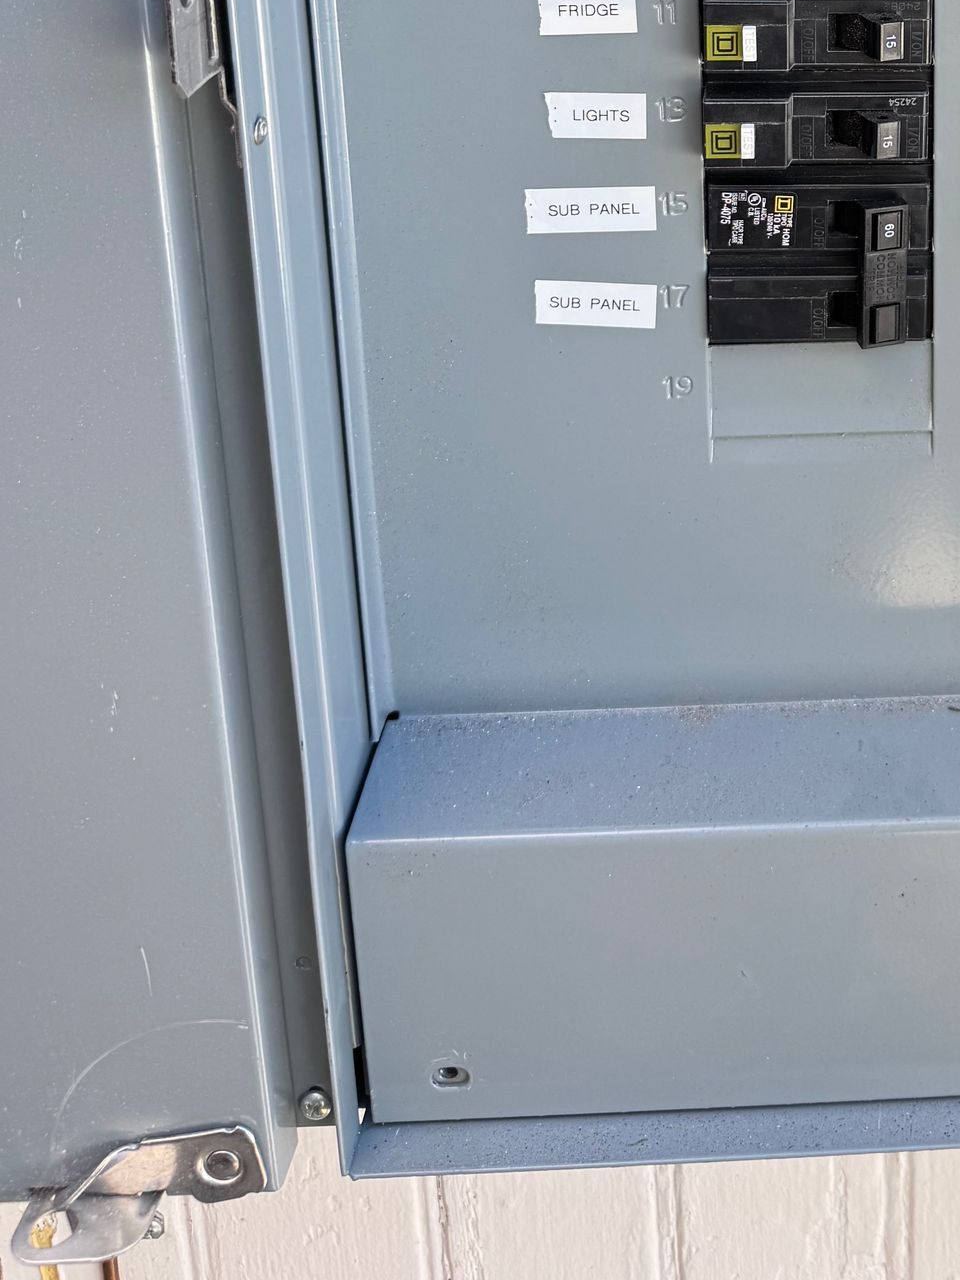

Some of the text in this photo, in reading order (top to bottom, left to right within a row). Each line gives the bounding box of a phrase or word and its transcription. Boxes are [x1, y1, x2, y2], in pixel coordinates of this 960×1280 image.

[558, 4, 619, 16] FRIDGE
[653, 0, 677, 25] 11
[745, 26, 756, 59] TEST
[886, 35, 896, 50] 15
[655, 96, 687, 122] 13
[889, 98, 917, 106] 24254
[573, 110, 630, 122] LIGHTS
[743, 125, 754, 158] TEST
[883, 134, 892, 149] 15
[548, 203, 640, 217] SUB PANEL
[658, 191, 688, 216] 15
[720, 192, 732, 224] DP-4075
[782, 228, 790, 246] HOM
[884, 223, 895, 238] 60
[550, 297, 640, 311] SUB PANEL
[659, 284, 690, 308] 17
[662, 375, 693, 400] 19
